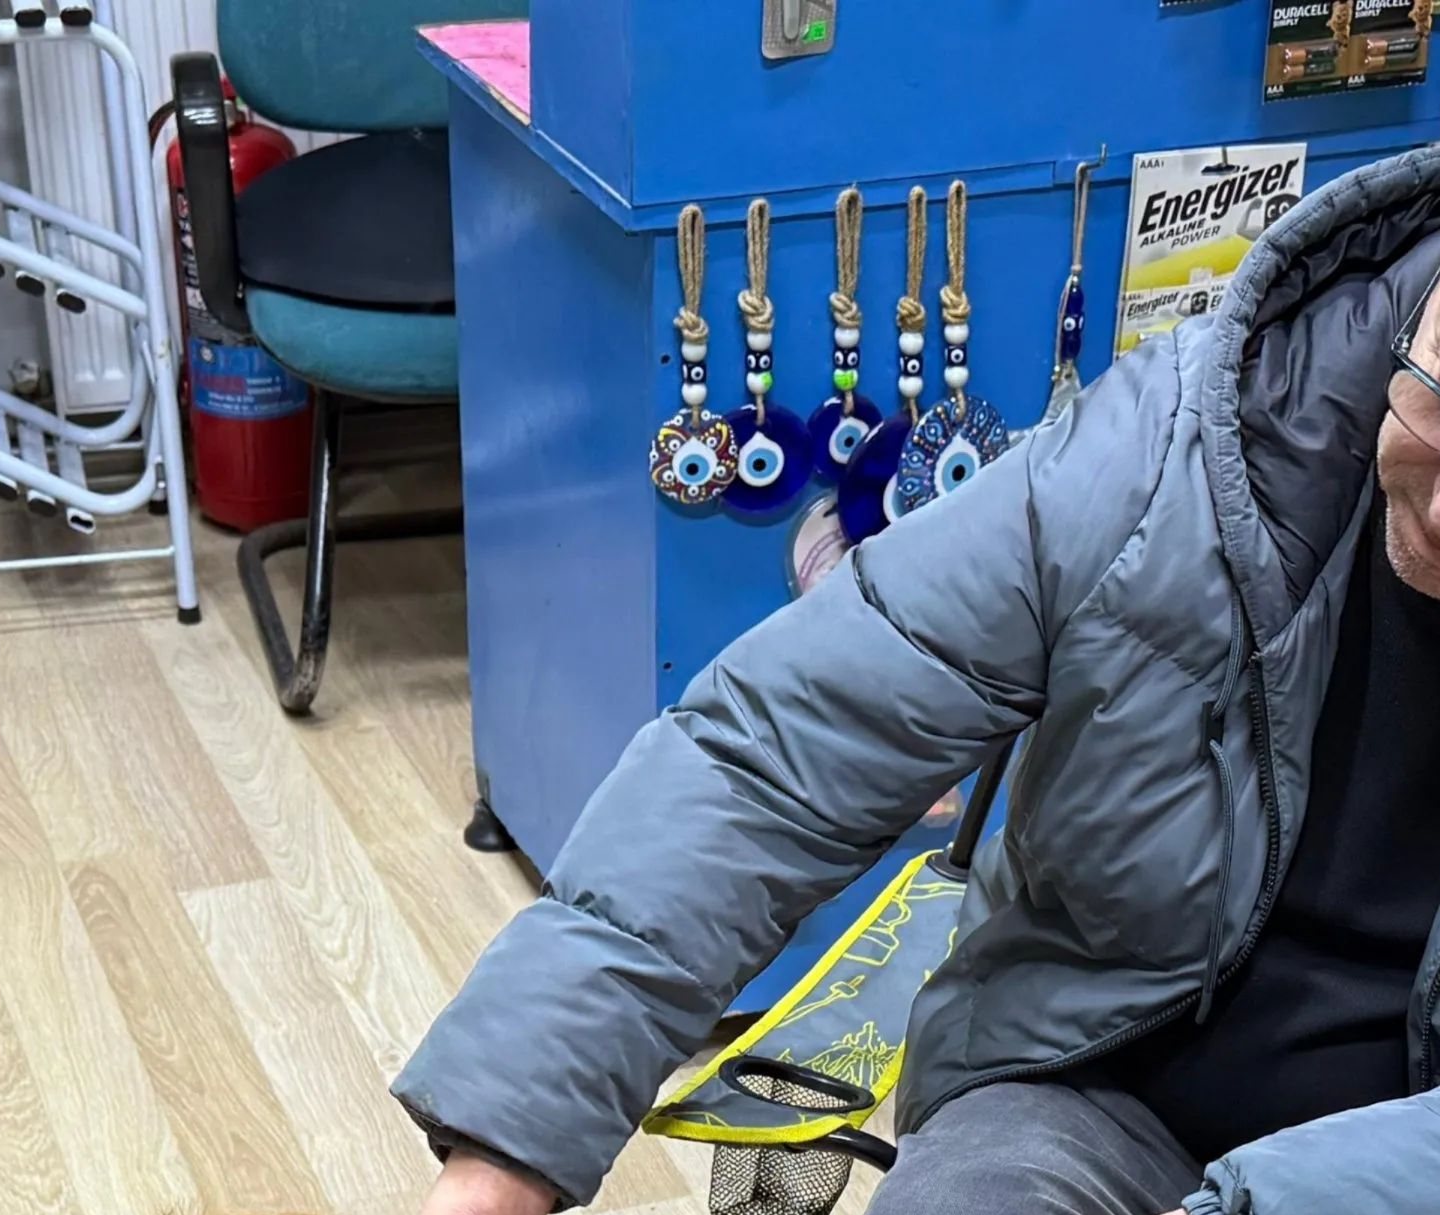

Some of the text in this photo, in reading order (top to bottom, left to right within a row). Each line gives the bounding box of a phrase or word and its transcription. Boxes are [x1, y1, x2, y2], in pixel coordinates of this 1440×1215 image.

[1274, 4, 1329, 21] DURACELL
[1138, 158, 1299, 236] Energizer
[1140, 218, 1207, 248] ALKALINE
[1171, 225, 1221, 249] POWER
